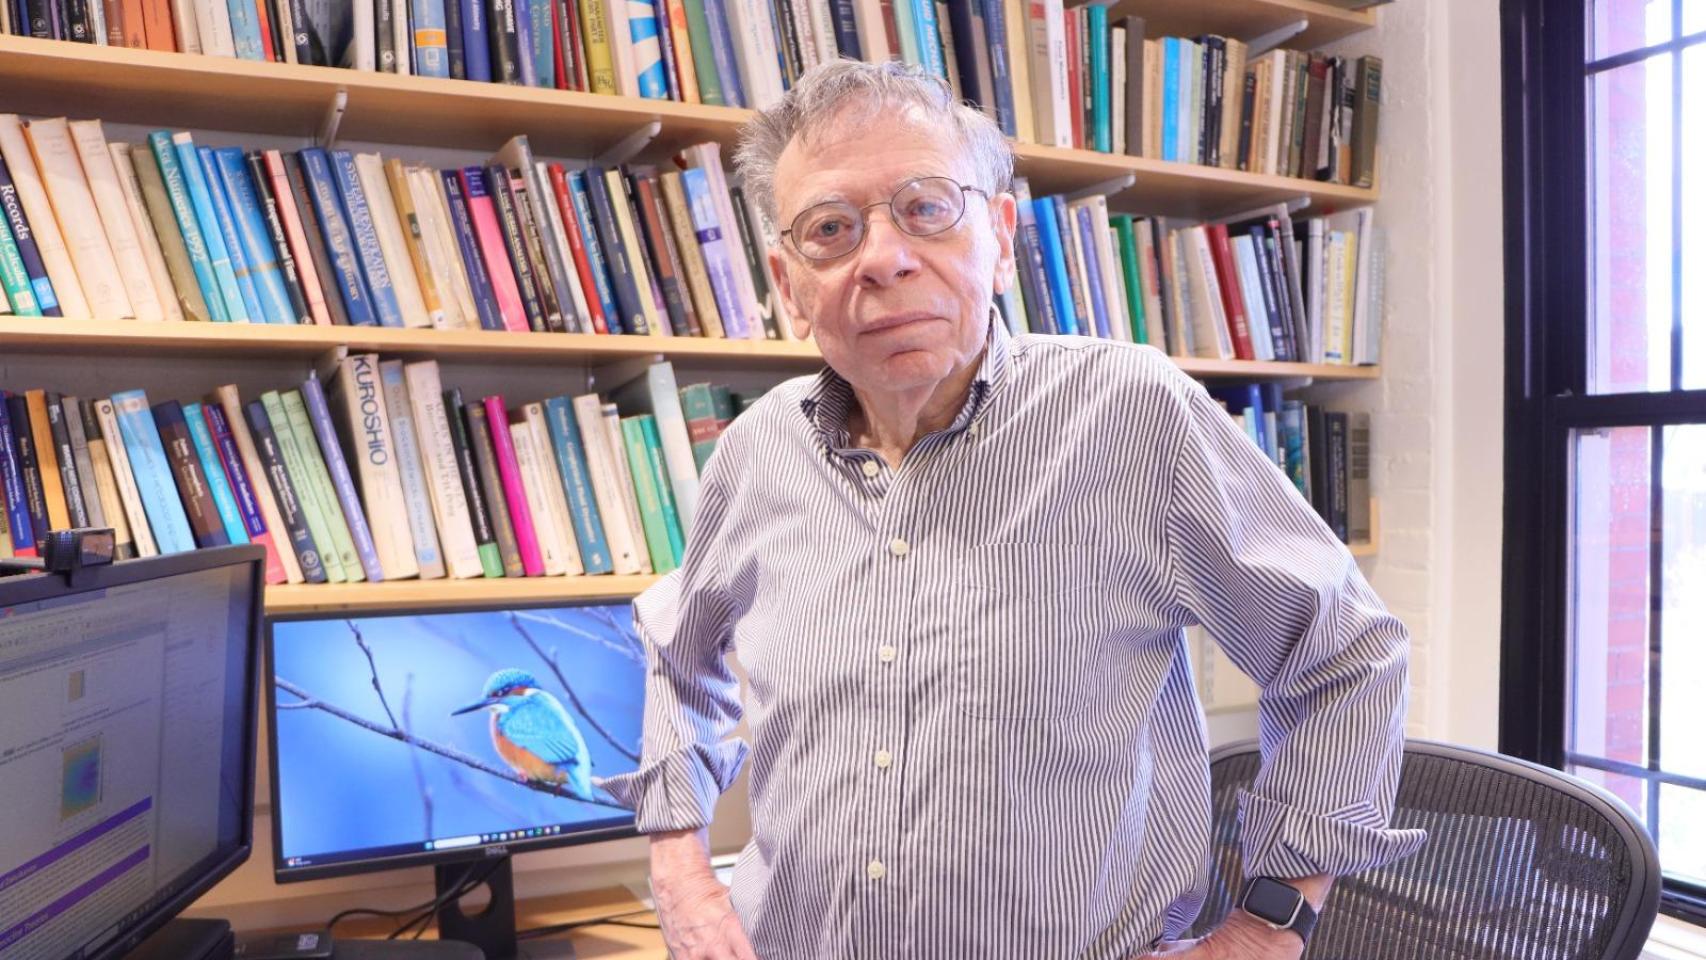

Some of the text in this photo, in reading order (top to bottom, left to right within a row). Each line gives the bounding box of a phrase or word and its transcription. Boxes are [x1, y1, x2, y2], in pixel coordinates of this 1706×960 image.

[1, 184, 30, 240] Records
[343, 159, 392, 290] SYSTEM IDENTIFICATION
[187, 231, 206, 261] 1992
[265, 196, 297, 283] Frequency and Time
[353, 355, 388, 466] KUROSHIO
[220, 438, 256, 516] Atmospheric Radiation
[279, 472, 295, 505] Introduction
[565, 440, 580, 487] Geophysical
[574, 485, 588, 508] Fluid
[580, 506, 597, 544] Dynamics
